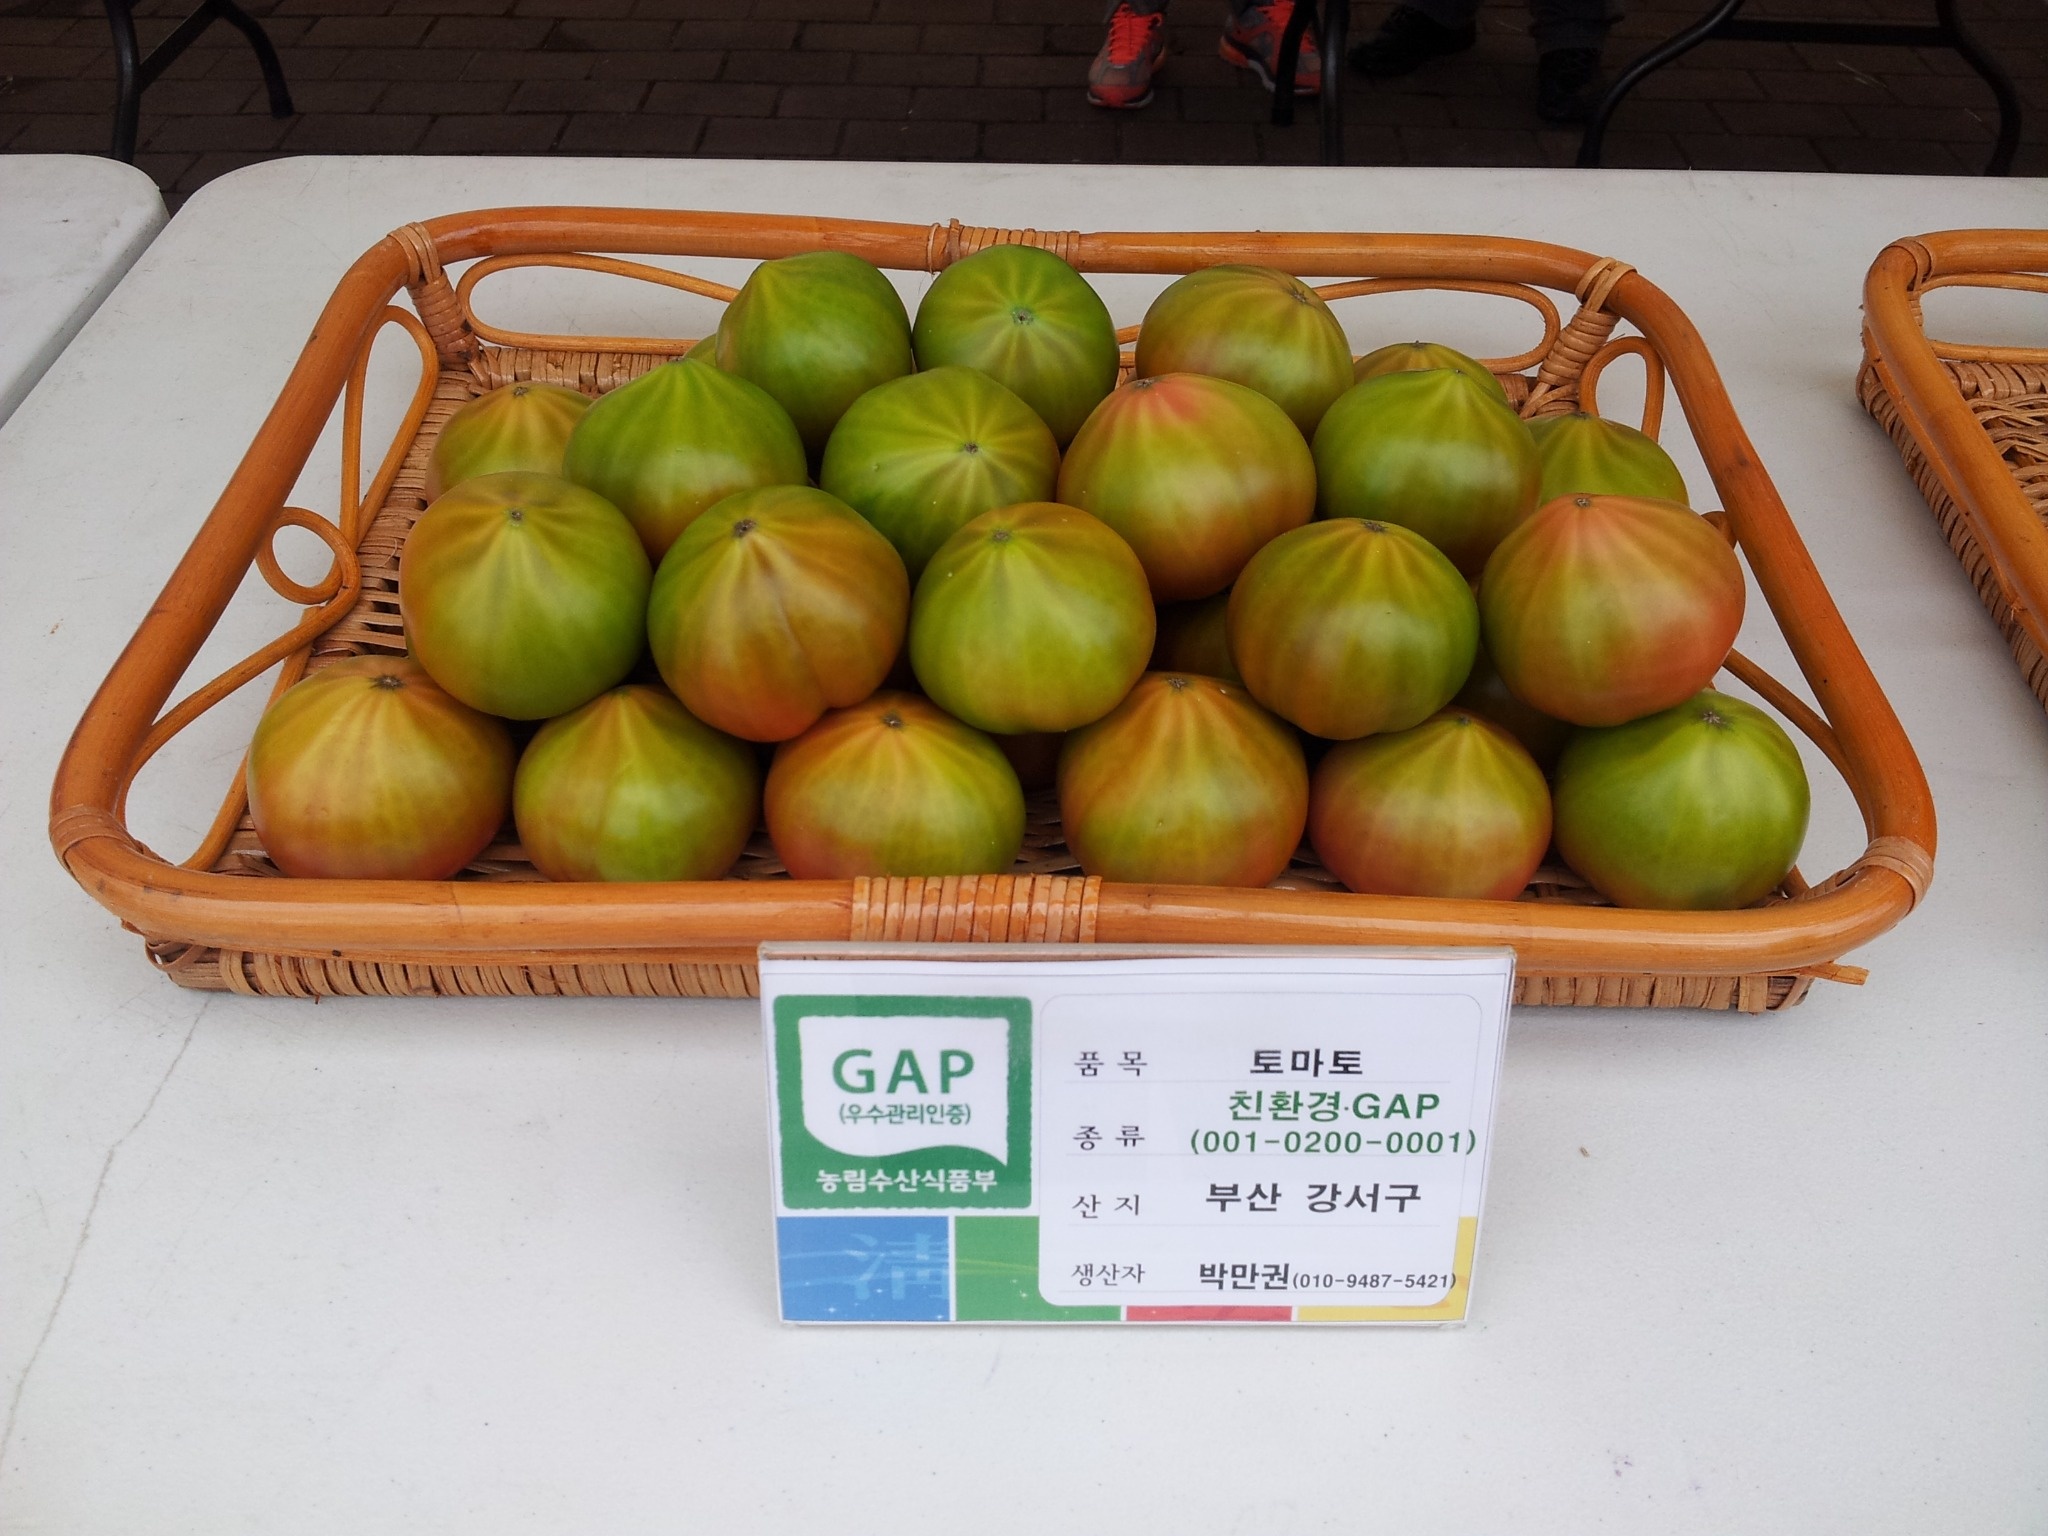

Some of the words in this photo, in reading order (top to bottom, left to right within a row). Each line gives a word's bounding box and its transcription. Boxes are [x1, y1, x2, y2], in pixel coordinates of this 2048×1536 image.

[831, 1048, 975, 1095] GAP
[1249, 1048, 1364, 1078] 토마토
[839, 1103, 972, 1126] (우수관리인증)
[1190, 1128, 1477, 1156] (001-0200-0001)
[816, 1168, 998, 1193] 농림수산식품부
[1205, 1182, 1283, 1213] 부산
[1306, 1182, 1422, 1214] 강서구
[1072, 1262, 1146, 1287] 생산자
